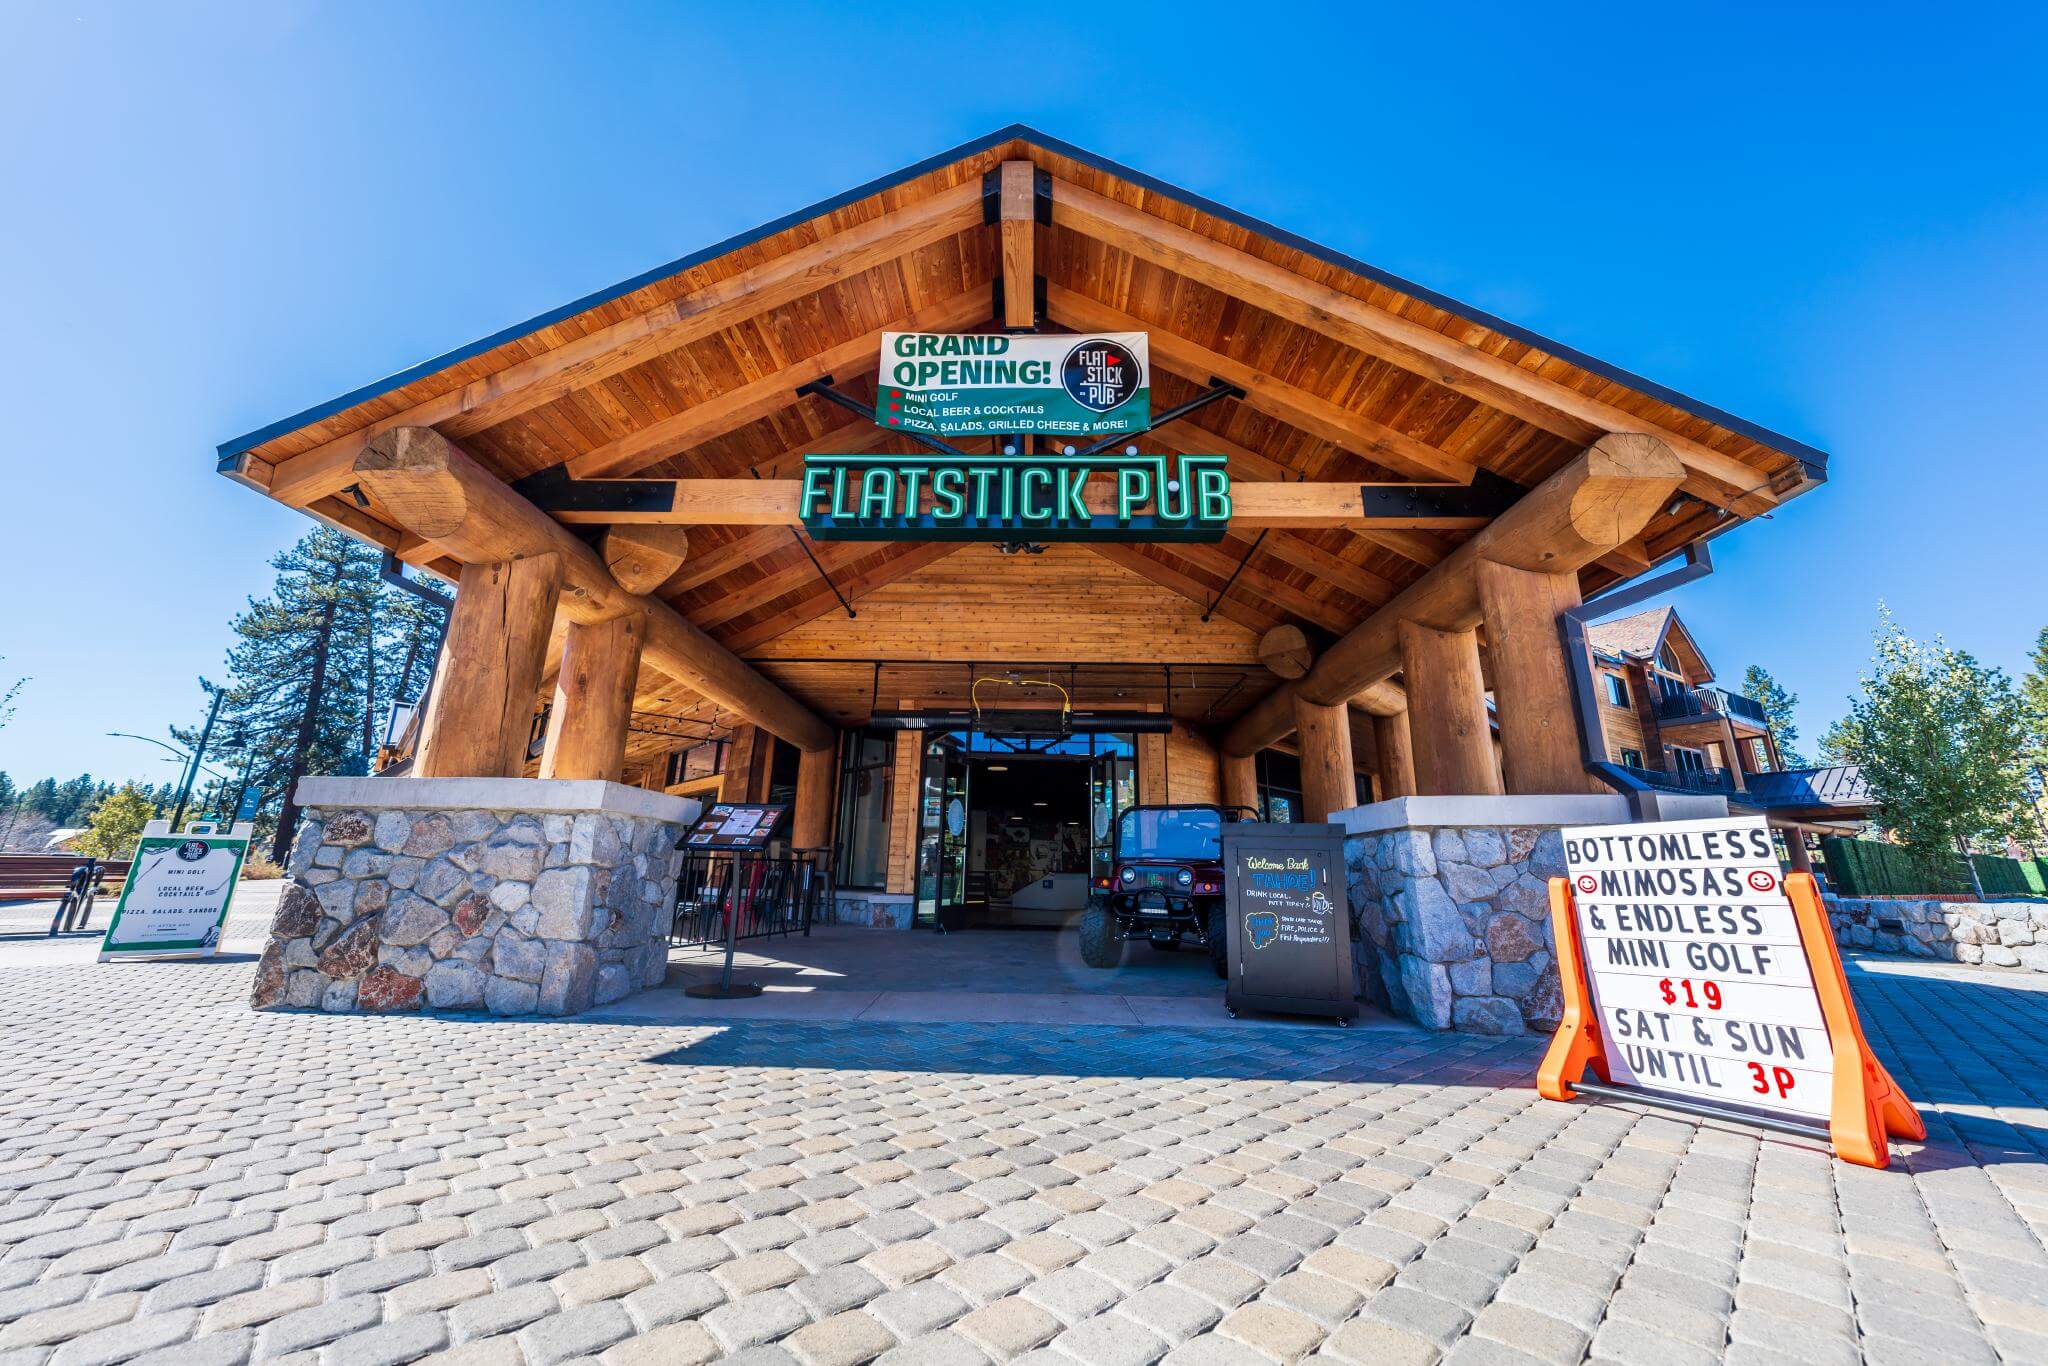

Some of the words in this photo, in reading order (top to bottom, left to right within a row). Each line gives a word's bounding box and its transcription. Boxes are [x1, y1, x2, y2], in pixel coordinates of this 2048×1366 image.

[894, 334, 1009, 358] GRAND
[1079, 350, 1108, 366] FLAT
[893, 360, 1052, 387] OPENING!
[1087, 366, 1123, 384] STICK
[905, 392, 928, 403] MINI
[929, 392, 959, 402] GOLF
[1089, 385, 1115, 405] PUB
[904, 404, 940, 417] LOCAL
[942, 406, 971, 417] BEER
[973, 406, 981, 415] &
[983, 405, 1044, 415] COCKTAILS
[904, 418, 937, 432] PIZZA,
[940, 421, 985, 432] SALADS,
[988, 420, 1034, 430] GRILLED
[1037, 420, 1080, 431] CHEESE
[1082, 422, 1090, 431] &
[1092, 419, 1128, 430] MORE!
[800, 466, 1092, 521] FLATSTICK
[1117, 455, 1232, 521] PUB
[1566, 829, 1771, 864] BOTTOMLESS
[1246, 856, 1285, 870] Welcome
[1287, 857, 1310, 870] Back
[1246, 889, 1268, 898] DRINK
[1601, 867, 1744, 897] MIMOSAS
[1589, 904, 1607, 930] &
[1615, 904, 1763, 935] ENDLESS
[1607, 937, 1670, 968] MINI
[1686, 942, 1771, 975] GOLF
[1659, 977, 1722, 1010] $19
[1615, 1007, 1670, 1042] SAT
[1692, 1016, 1714, 1047] &
[1725, 1020, 1805, 1060] SUN
[1626, 1044, 1722, 1088] UNTIL
[1747, 1061, 1795, 1099] 3P
